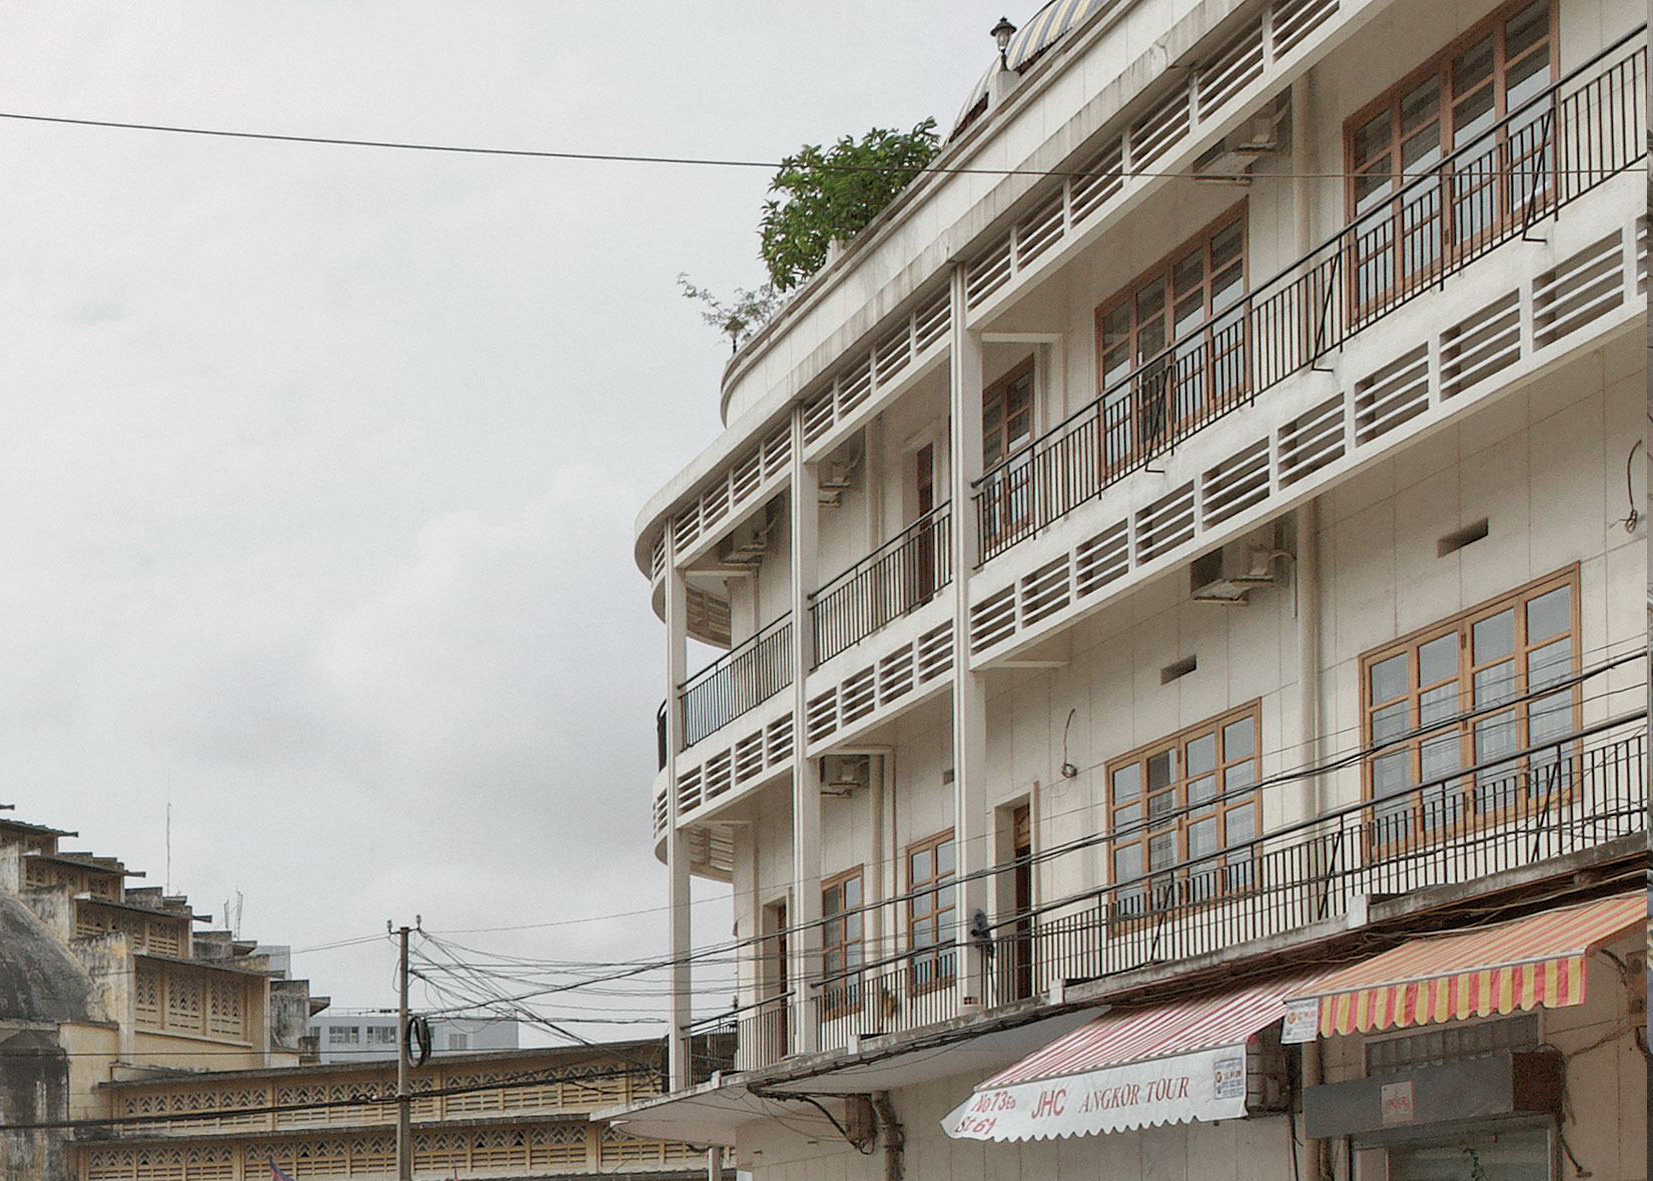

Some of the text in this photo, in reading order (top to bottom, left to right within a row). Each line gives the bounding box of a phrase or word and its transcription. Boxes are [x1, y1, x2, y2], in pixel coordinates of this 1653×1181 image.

[1031, 1088, 1066, 1119] JHC
[1078, 1083, 1141, 1114] ANGKOR
[1146, 1076, 1190, 1103] TOUR
